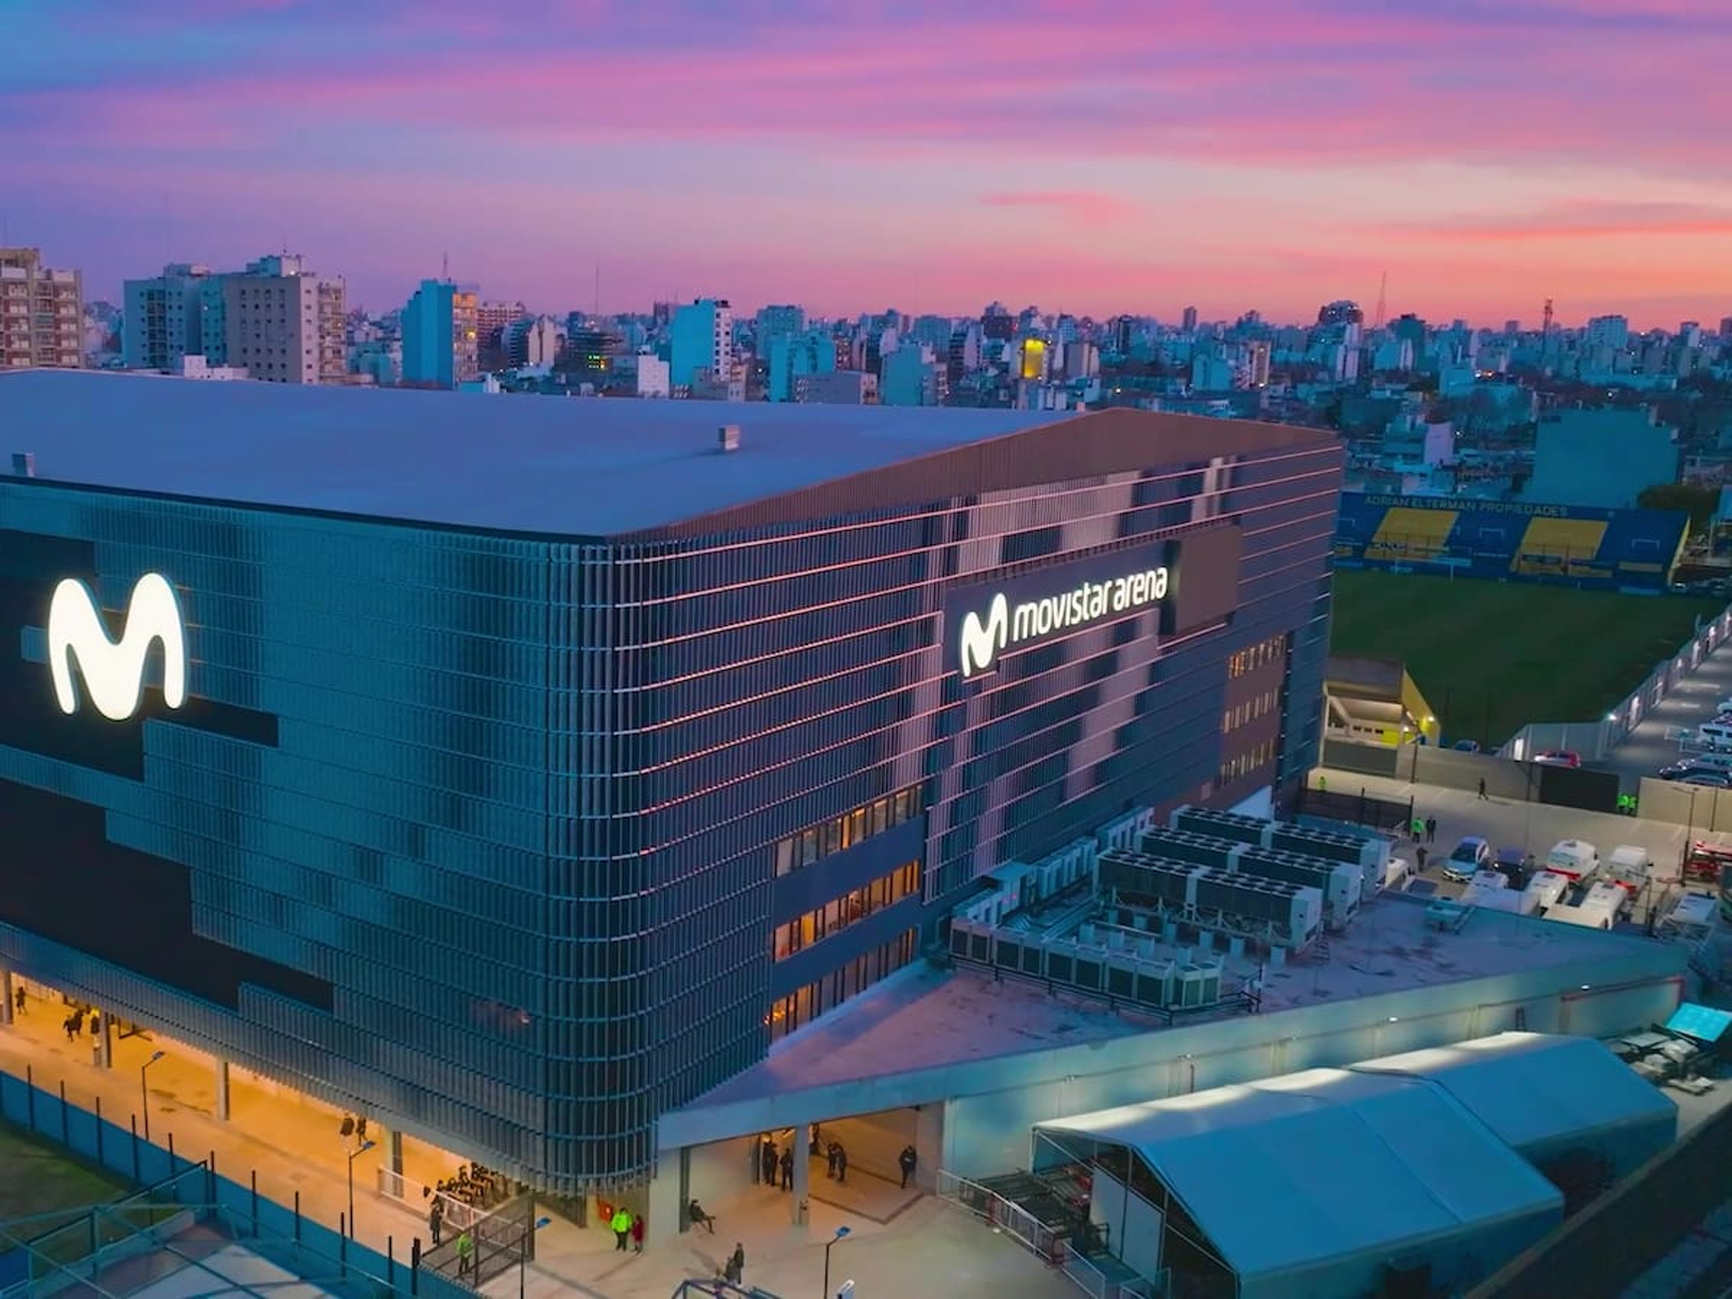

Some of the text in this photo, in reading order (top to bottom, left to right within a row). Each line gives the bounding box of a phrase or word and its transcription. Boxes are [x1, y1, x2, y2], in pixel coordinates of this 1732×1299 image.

[1411, 498, 1475, 512] ELTERMAN
[1479, 502, 1567, 517] PROPIEDADES
[1013, 582, 1113, 641] movistar
[1114, 567, 1167, 611] arena
